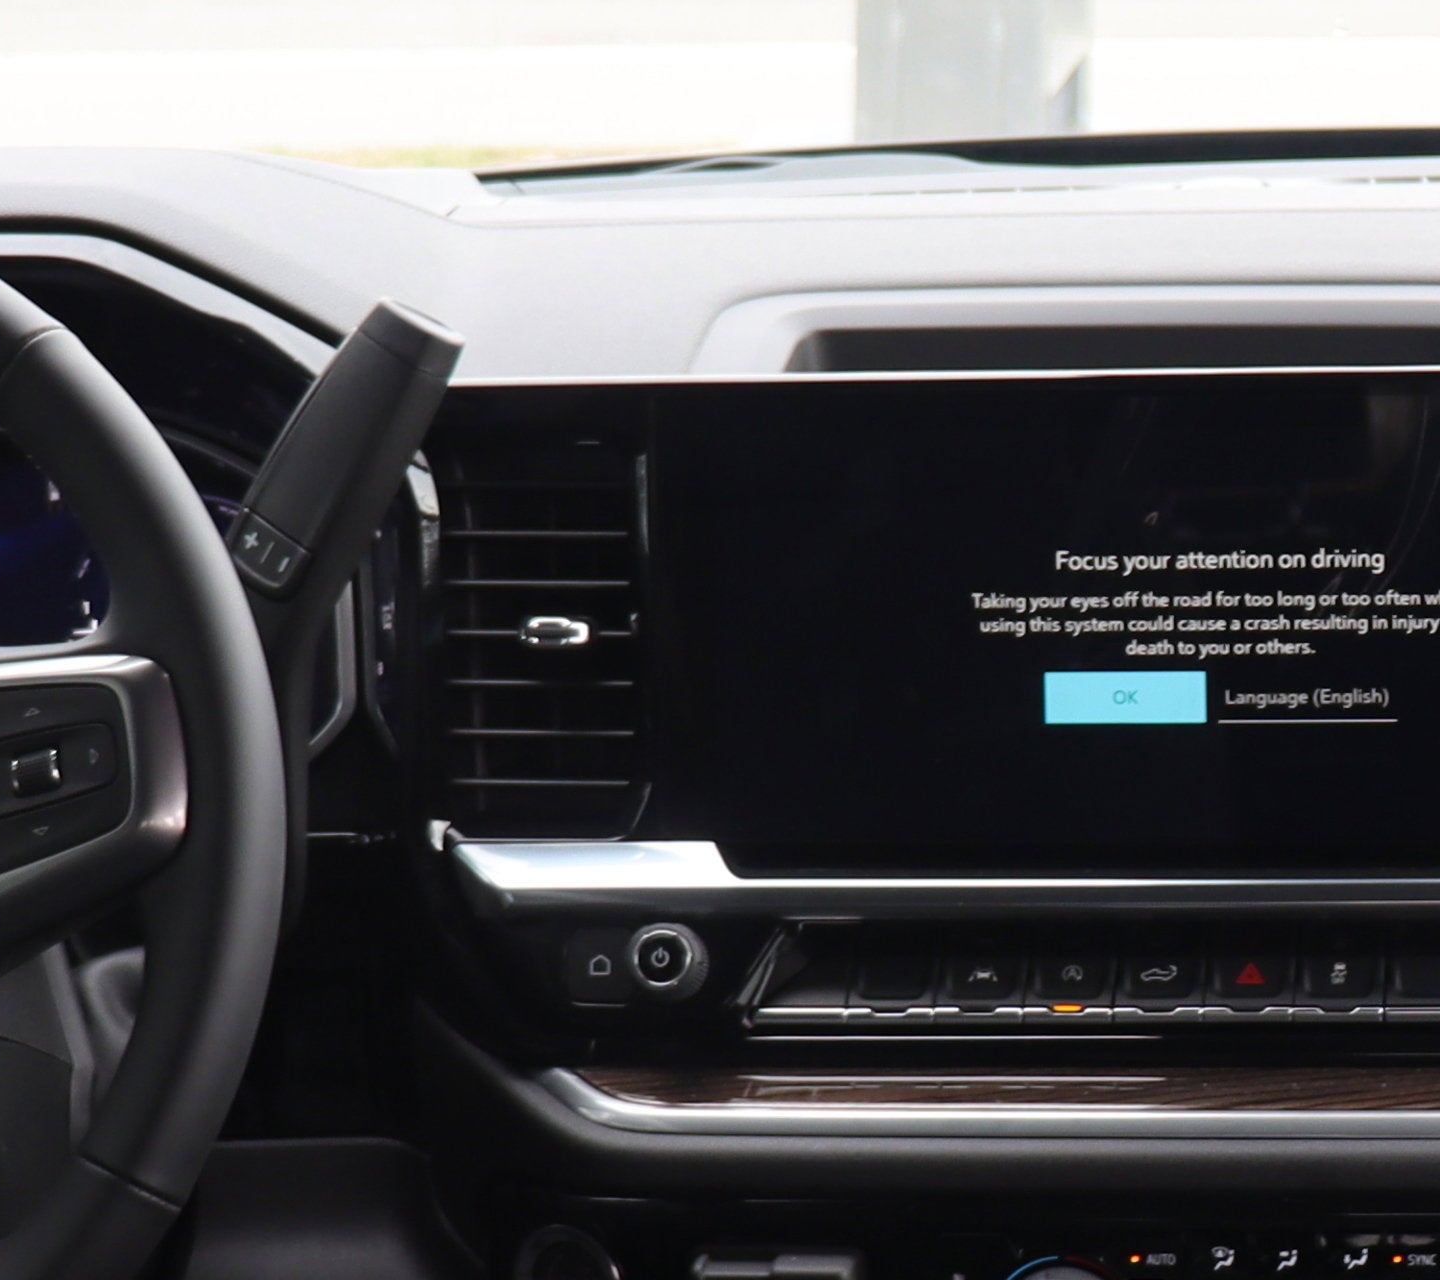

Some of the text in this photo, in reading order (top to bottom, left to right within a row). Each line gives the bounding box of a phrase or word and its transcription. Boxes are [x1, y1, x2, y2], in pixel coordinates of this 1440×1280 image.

[1055, 548, 1385, 576] Focus your attention on driving
[972, 592, 1026, 612] Taking
[1029, 596, 1067, 612] your
[1070, 595, 1109, 612] eyes
[1113, 591, 1139, 608] off
[1142, 591, 1169, 607] the
[1173, 591, 1212, 607] road
[1216, 591, 1240, 606] for
[1244, 592, 1273, 606] too
[1277, 591, 1315, 610] long
[1319, 594, 1339, 605] or
[1342, 592, 1370, 605] too
[1374, 590, 1421, 605] often
[980, 618, 1026, 637] using
[1030, 616, 1061, 632] this
[1064, 618, 1124, 636] system
[1127, 615, 1174, 631] could
[1177, 618, 1226, 631] cause
[1230, 619, 1241, 630] a
[1244, 614, 1291, 630] crash
[1294, 614, 1368, 634] resulting
[1373, 615, 1388, 629] in
[1392, 615, 1440, 633] injury
[1125, 639, 1316, 659] death to you or others.
[1112, 689, 1139, 705] OK
[1224, 687, 1390, 709] Language (English)
[1146, 1253, 1176, 1265] AUTO
[1407, 1254, 1437, 1266] SYNC
